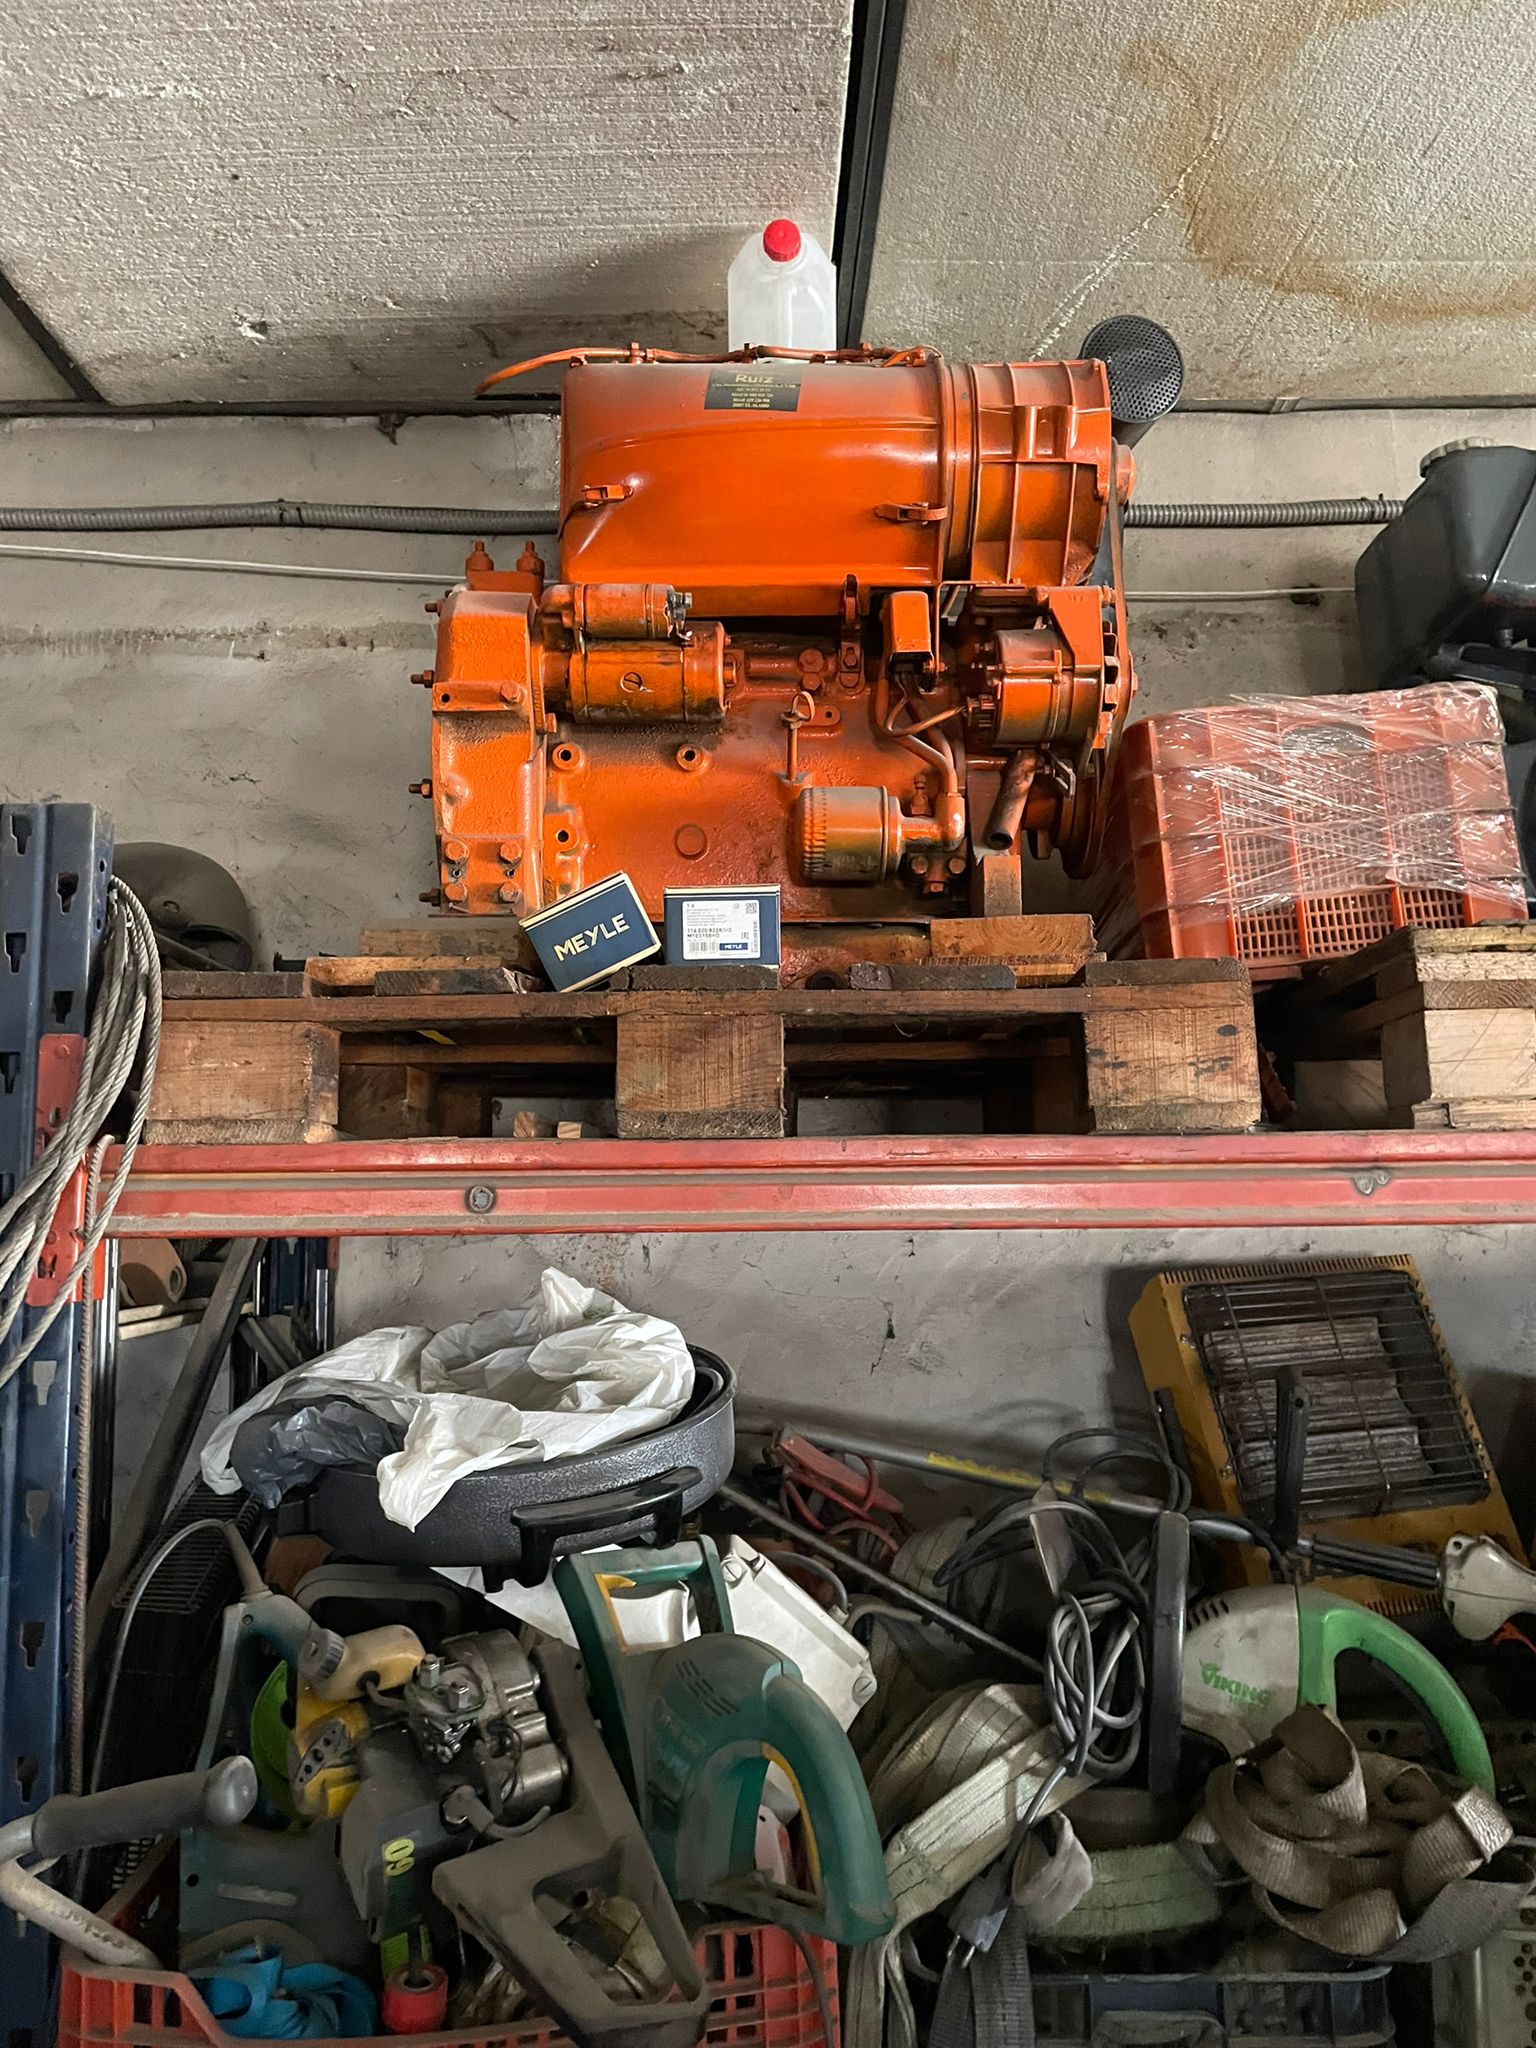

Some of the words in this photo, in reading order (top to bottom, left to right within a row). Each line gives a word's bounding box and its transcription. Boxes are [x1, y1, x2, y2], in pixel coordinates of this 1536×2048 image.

[735, 374, 774, 383] Ruiz
[553, 913, 631, 961] MEYLE
[1200, 1662, 1275, 1706] VIKING
